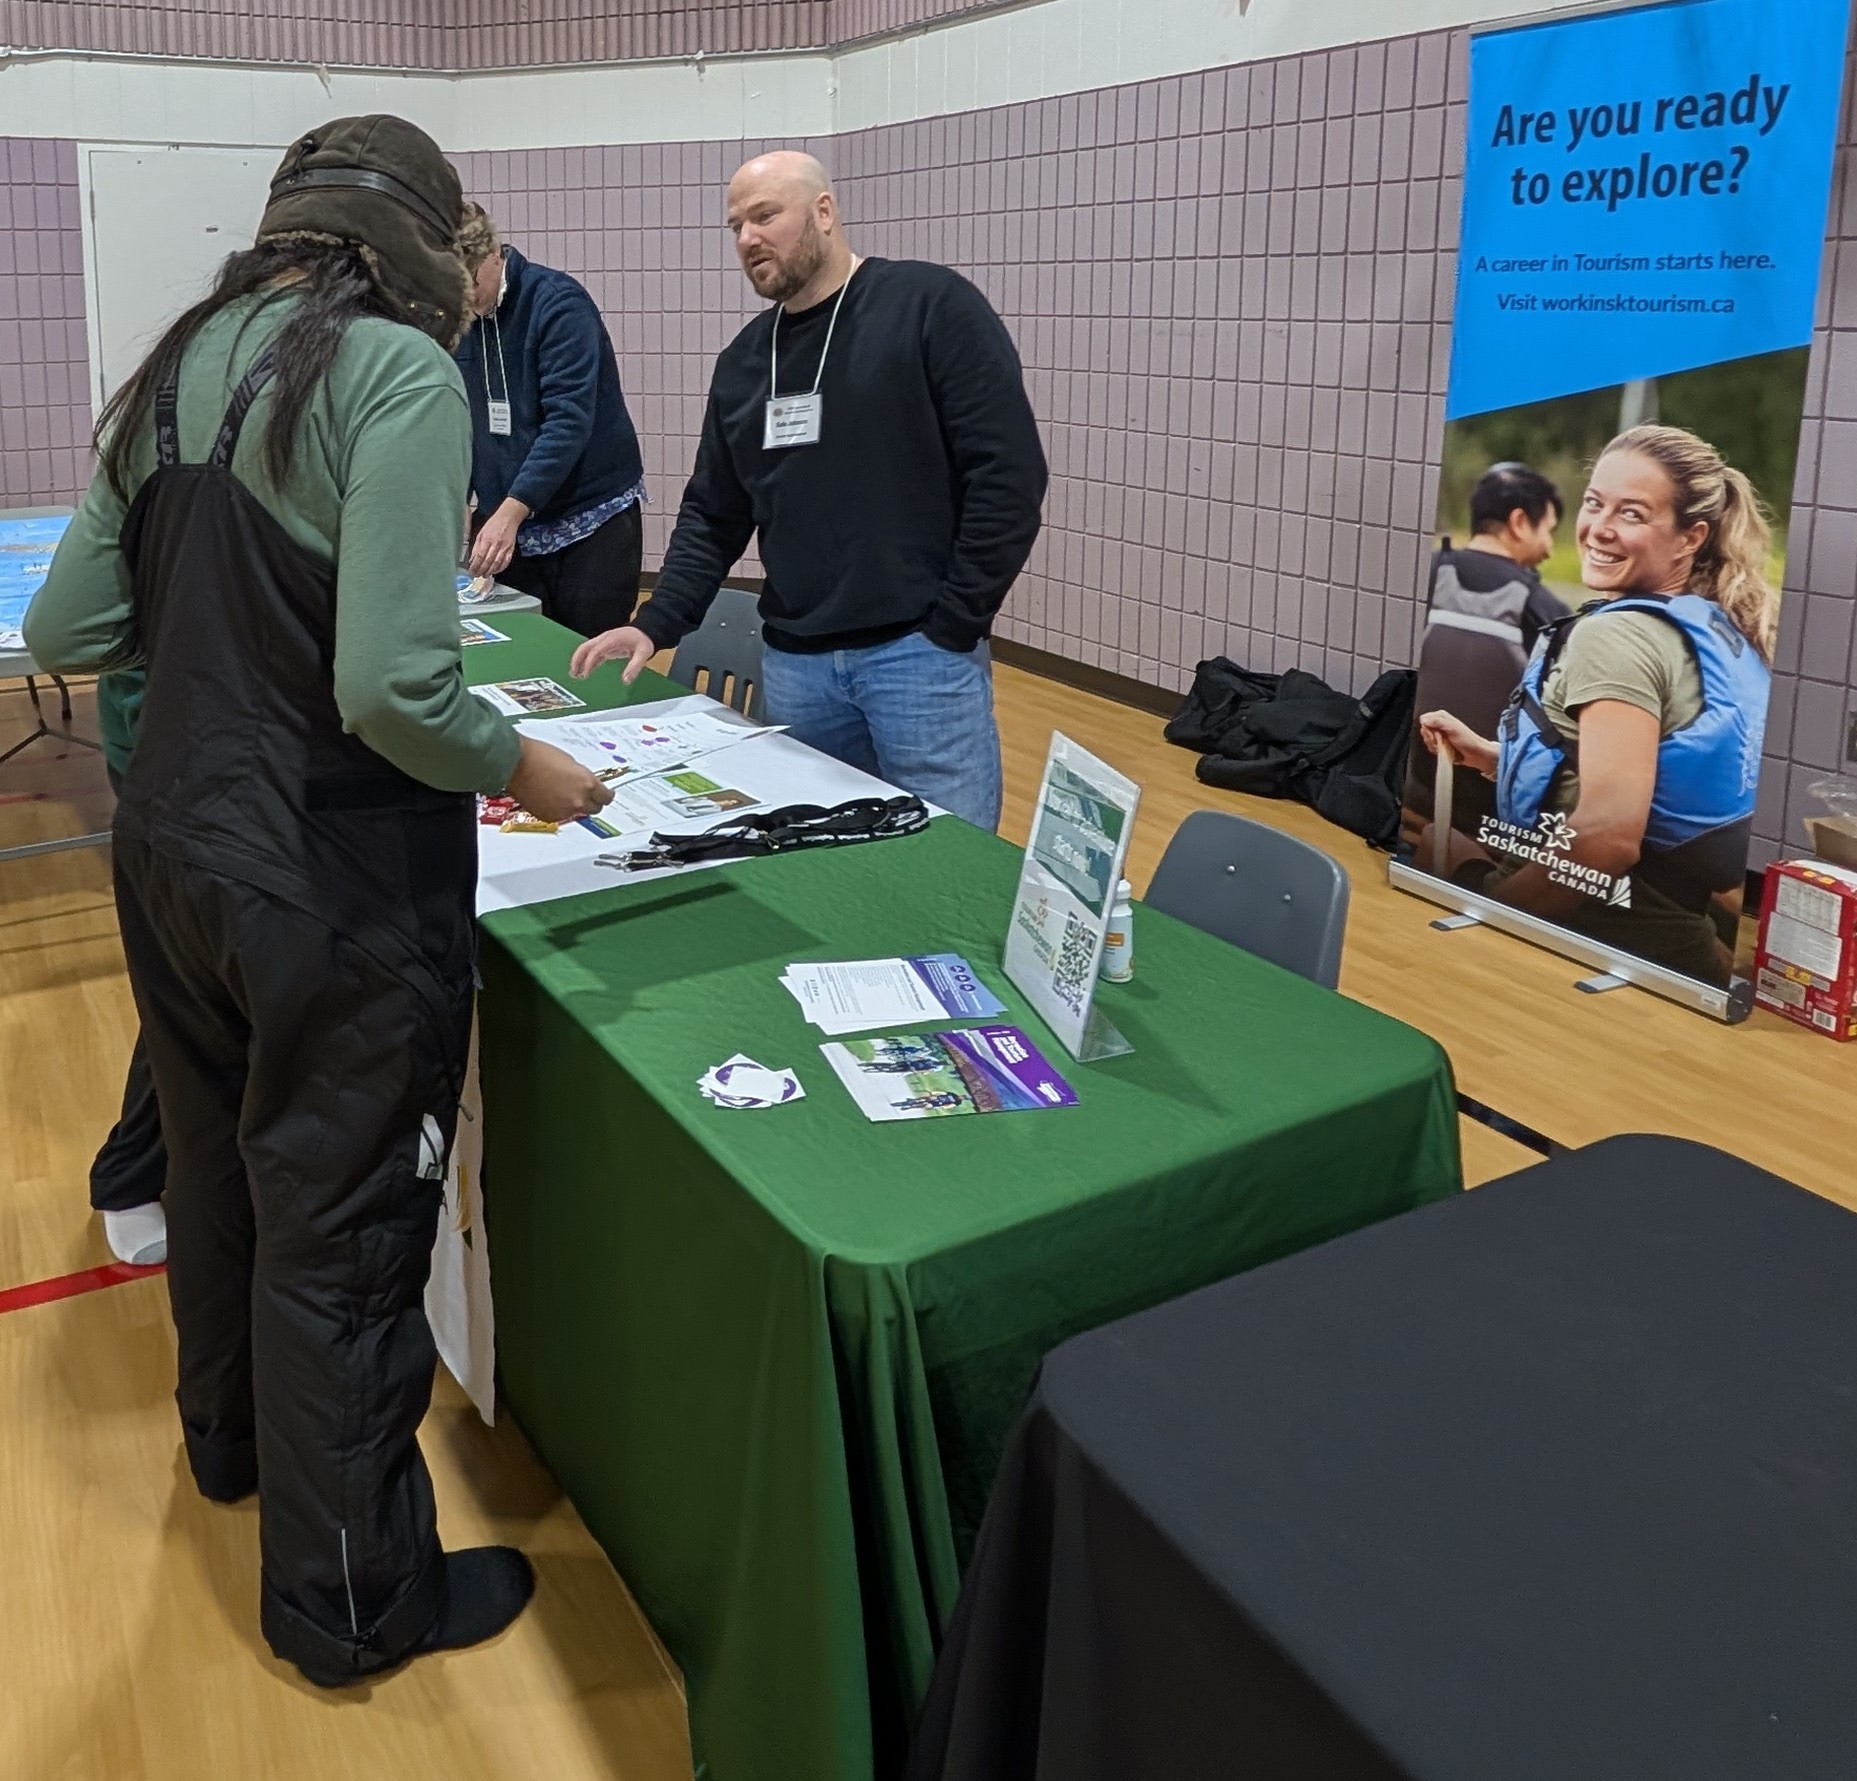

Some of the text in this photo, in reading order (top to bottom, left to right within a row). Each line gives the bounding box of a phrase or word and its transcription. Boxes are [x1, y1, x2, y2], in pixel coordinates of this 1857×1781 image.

[1491, 73, 1792, 152] Are you ready
[1511, 145, 1749, 212] to explore?
[1475, 250, 1776, 272] A career in Tourism starts here.
[1497, 292, 1735, 313] Visit workinsktourism.ca
[1481, 815, 1543, 844] TOURISM
[1476, 827, 1611, 887] Saskatchewan
[1548, 871, 1608, 900] CANADA
